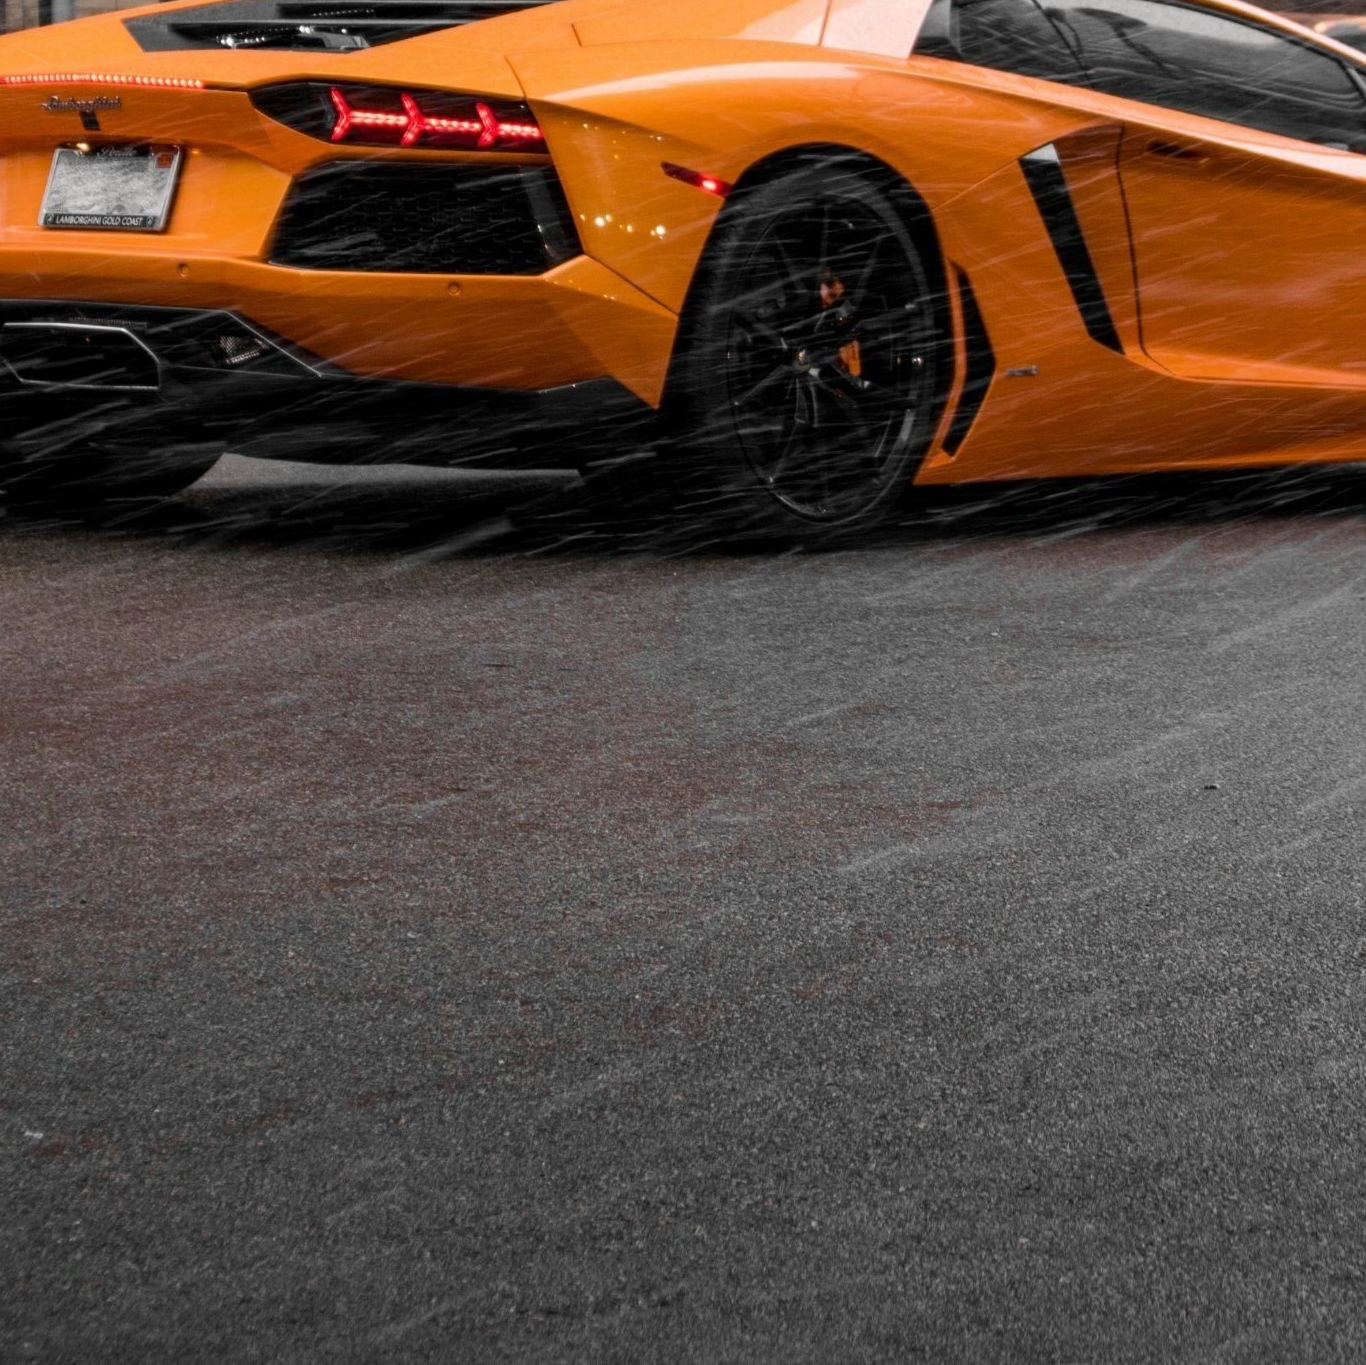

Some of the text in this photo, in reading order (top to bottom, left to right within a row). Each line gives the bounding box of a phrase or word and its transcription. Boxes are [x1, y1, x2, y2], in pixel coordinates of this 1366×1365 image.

[41, 95, 123, 112] Lamborghini
[55, 216, 144, 227] LAMBORGHINI GOLD COAST
